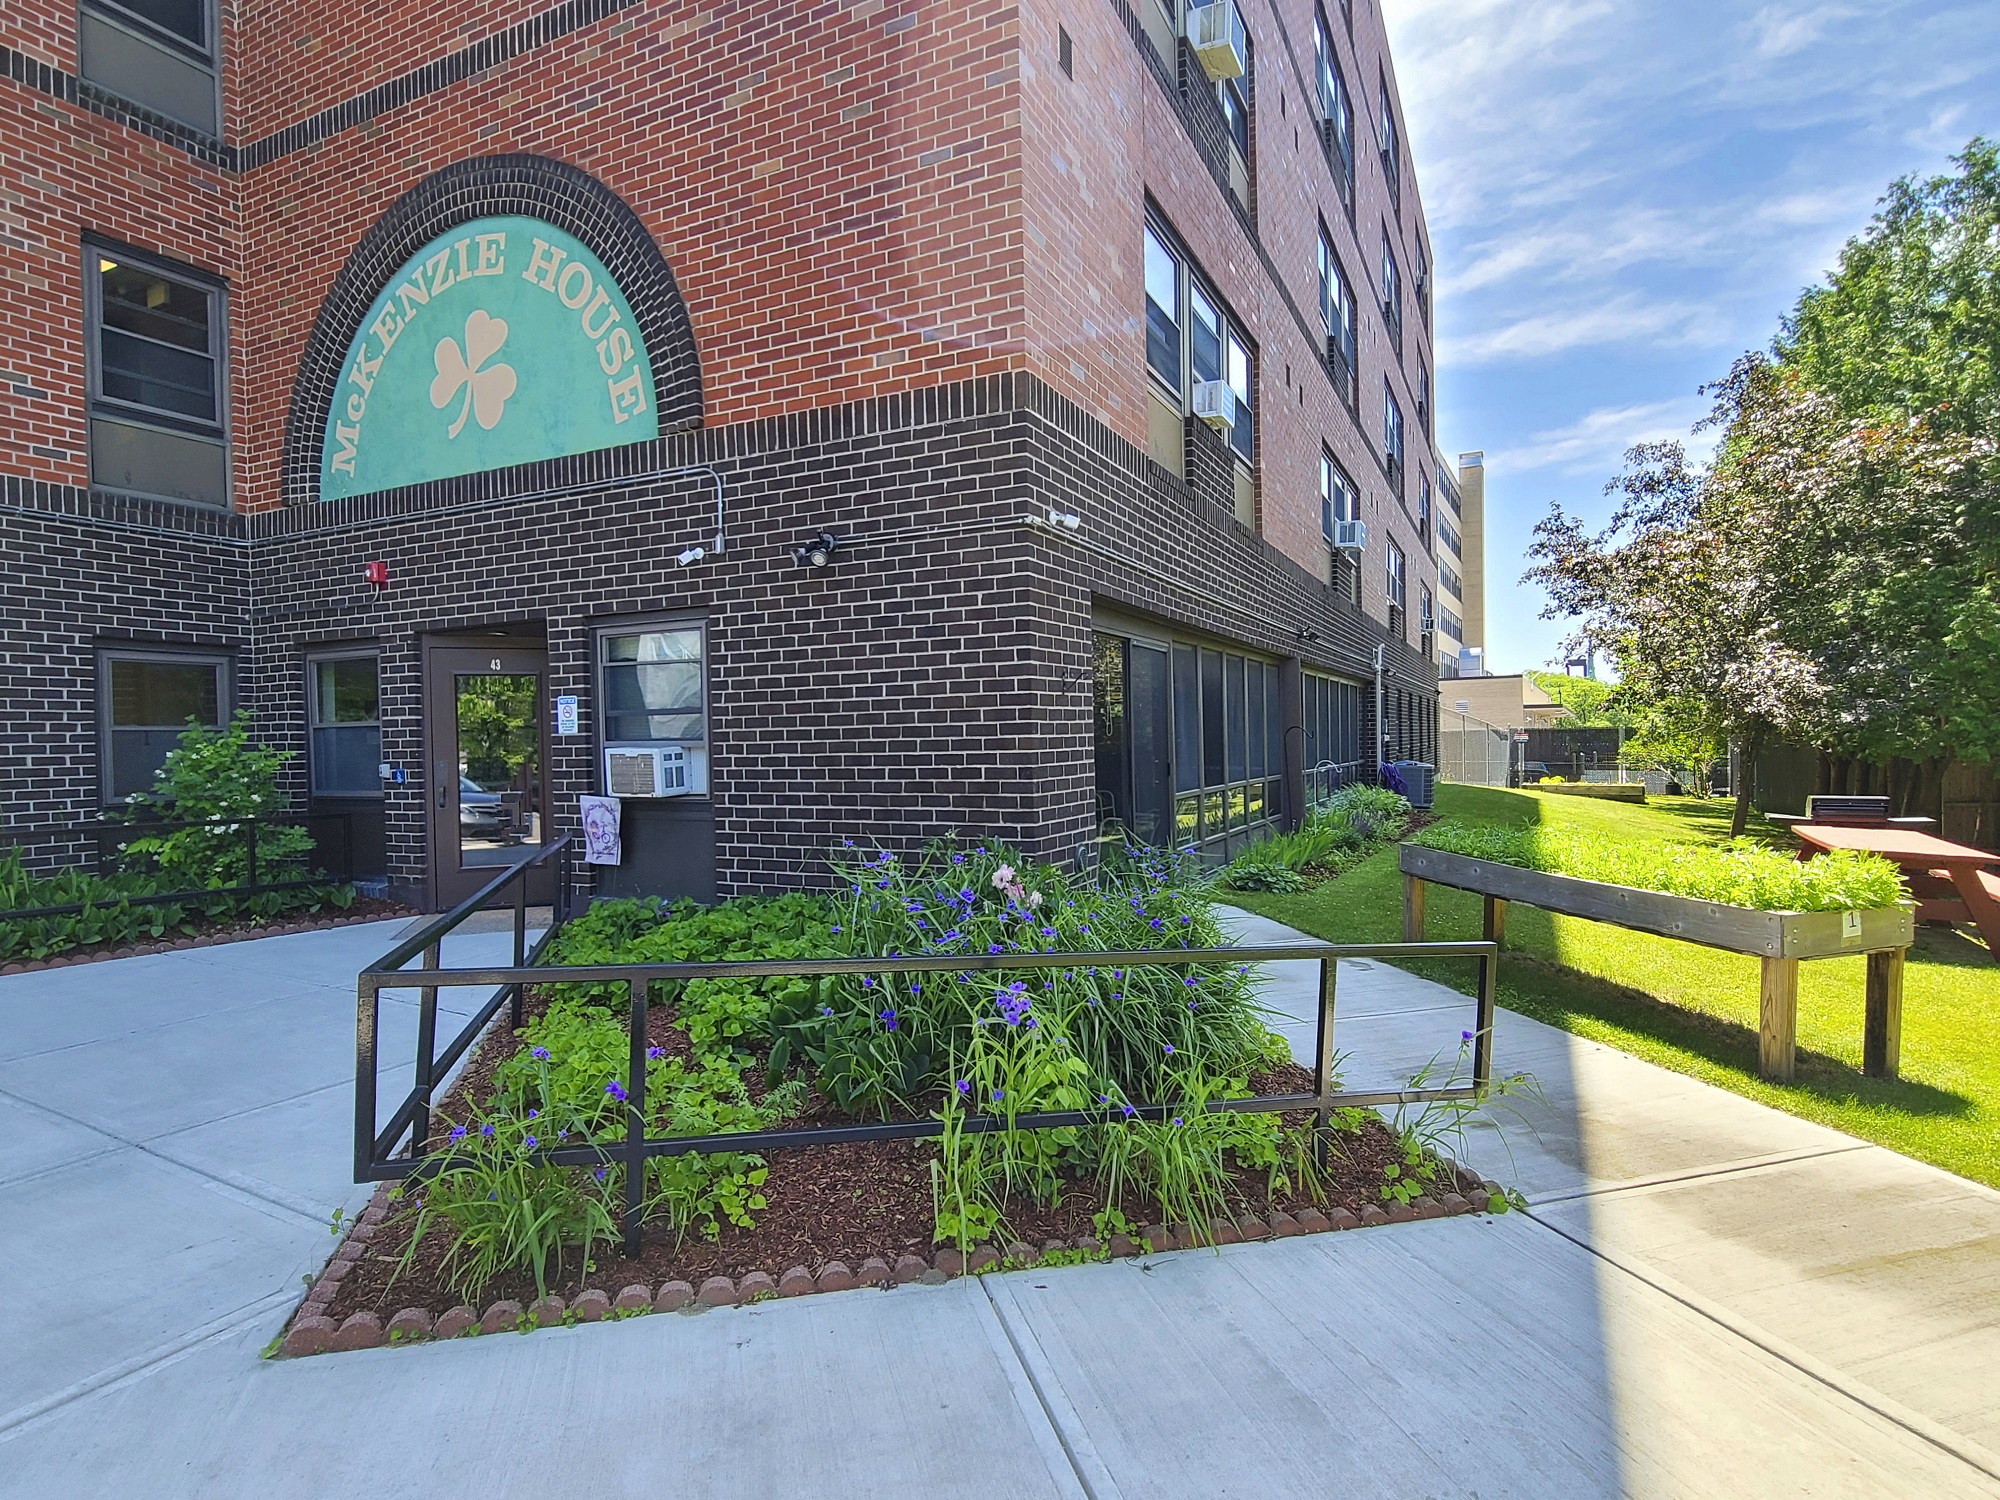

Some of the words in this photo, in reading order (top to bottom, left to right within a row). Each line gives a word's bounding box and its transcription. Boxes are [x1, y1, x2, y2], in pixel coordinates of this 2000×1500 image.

[331, 232, 506, 478] McKENZIE
[522, 237, 648, 425] HOUSE
[490, 659, 501, 670] 43
[1848, 911, 1857, 927] 1
